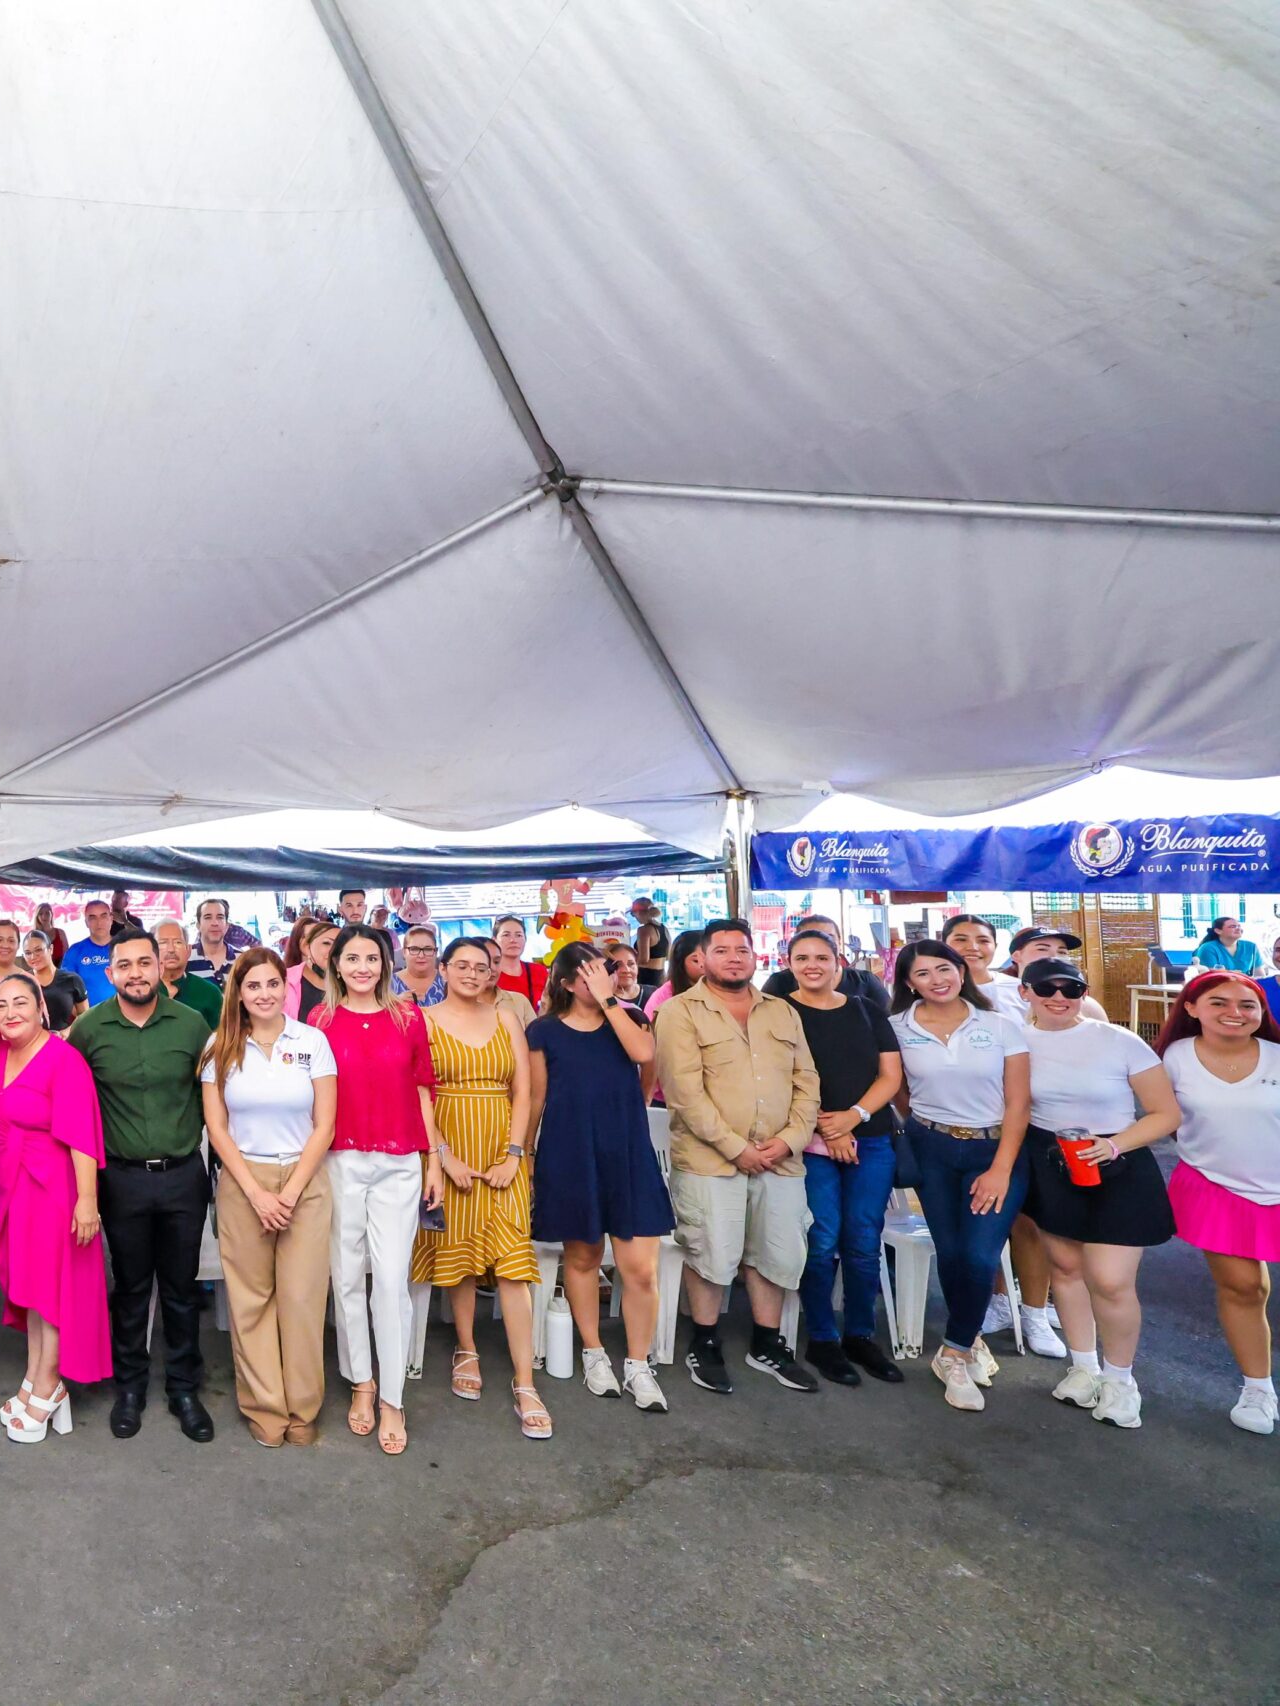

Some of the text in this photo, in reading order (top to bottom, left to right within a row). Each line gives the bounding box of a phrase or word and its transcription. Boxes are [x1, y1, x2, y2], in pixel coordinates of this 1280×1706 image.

[819, 837, 889, 864] Blanquita
[1140, 823, 1266, 858] Blanquita
[1138, 862, 1270, 873] AGUA PURIFICADA
